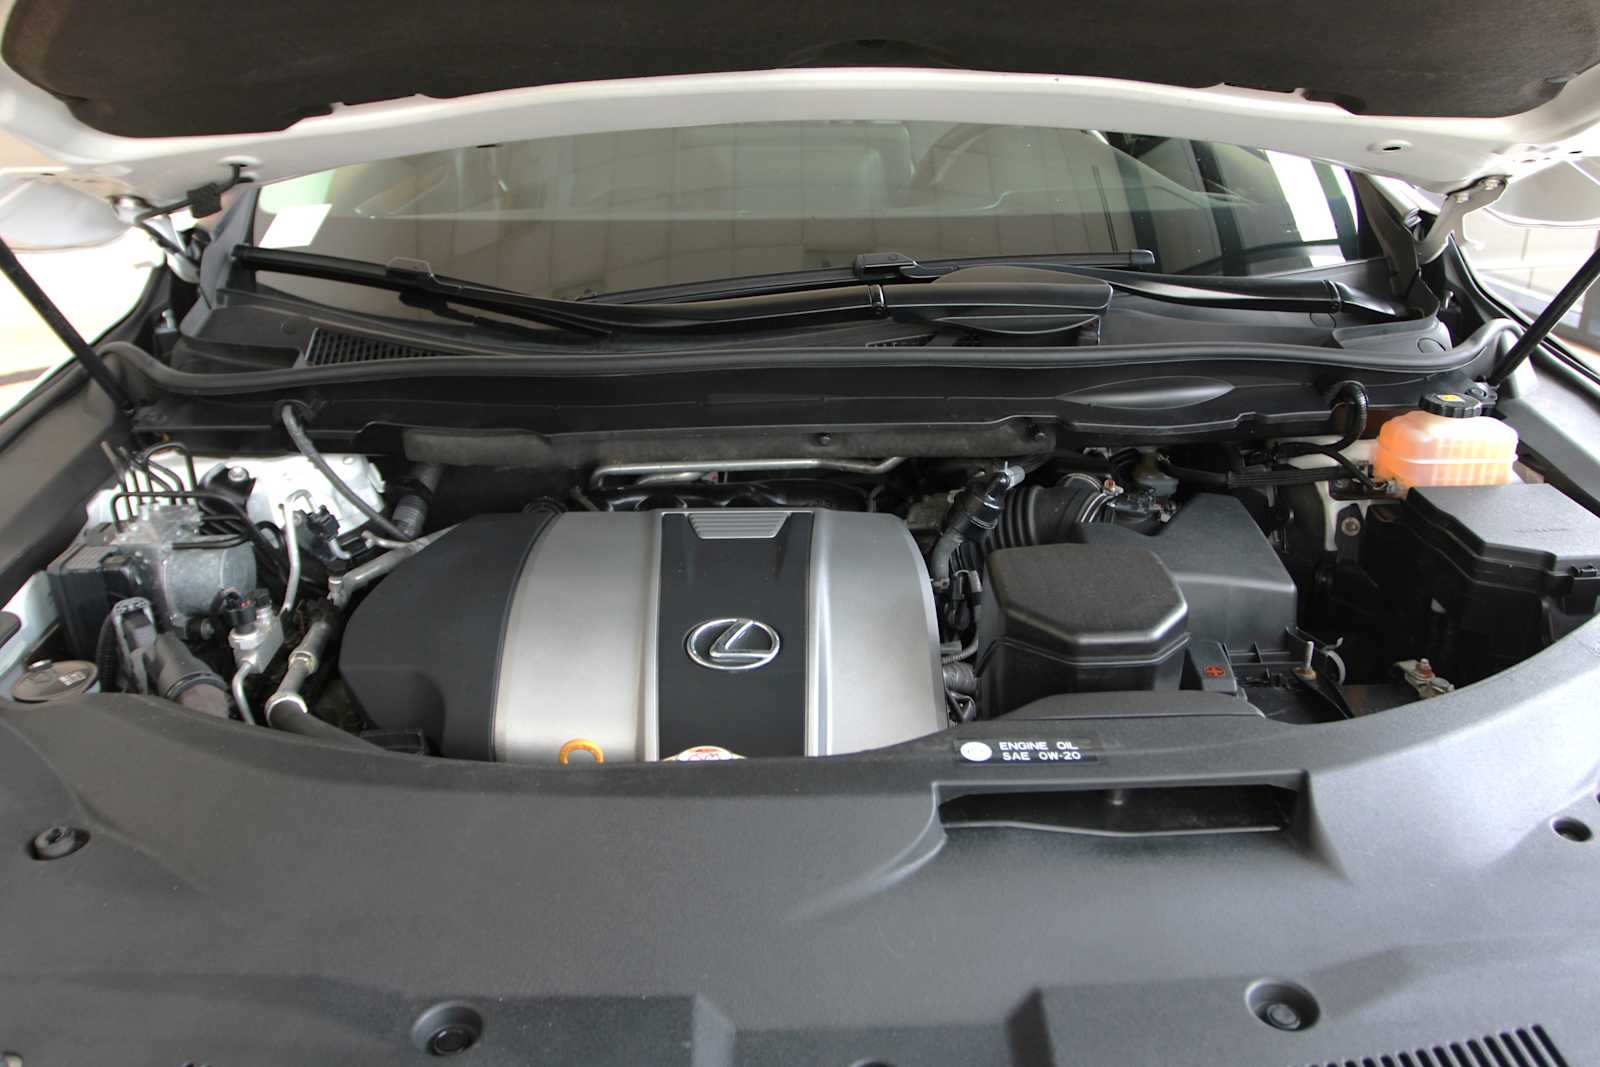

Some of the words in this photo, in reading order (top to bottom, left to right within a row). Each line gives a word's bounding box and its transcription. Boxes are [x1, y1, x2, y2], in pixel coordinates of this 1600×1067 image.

[999, 741, 1048, 750] ENGINE
[1056, 741, 1079, 750] OIL
[1002, 751, 1030, 761] SAE
[1038, 751, 1081, 760] 0W-20
